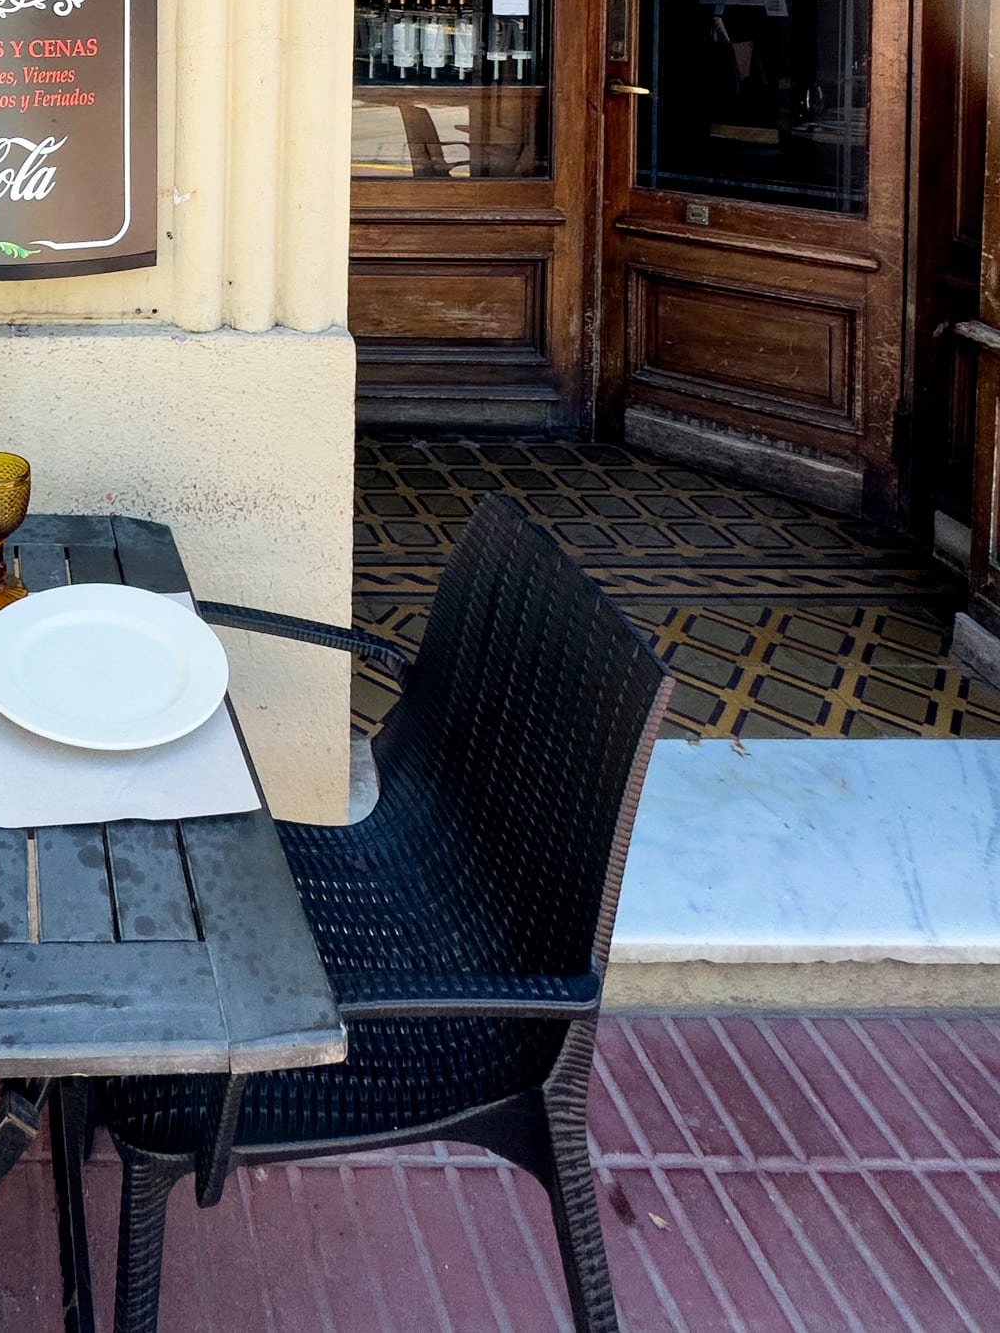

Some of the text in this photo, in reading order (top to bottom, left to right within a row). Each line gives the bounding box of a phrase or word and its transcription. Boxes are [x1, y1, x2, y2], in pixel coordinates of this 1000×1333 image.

[10, 40, 24, 57] Y
[29, 39, 98, 57] CENAS
[23, 66, 75, 83] Viernes
[20, 95, 30, 112] y
[33, 89, 94, 106] Feriados
